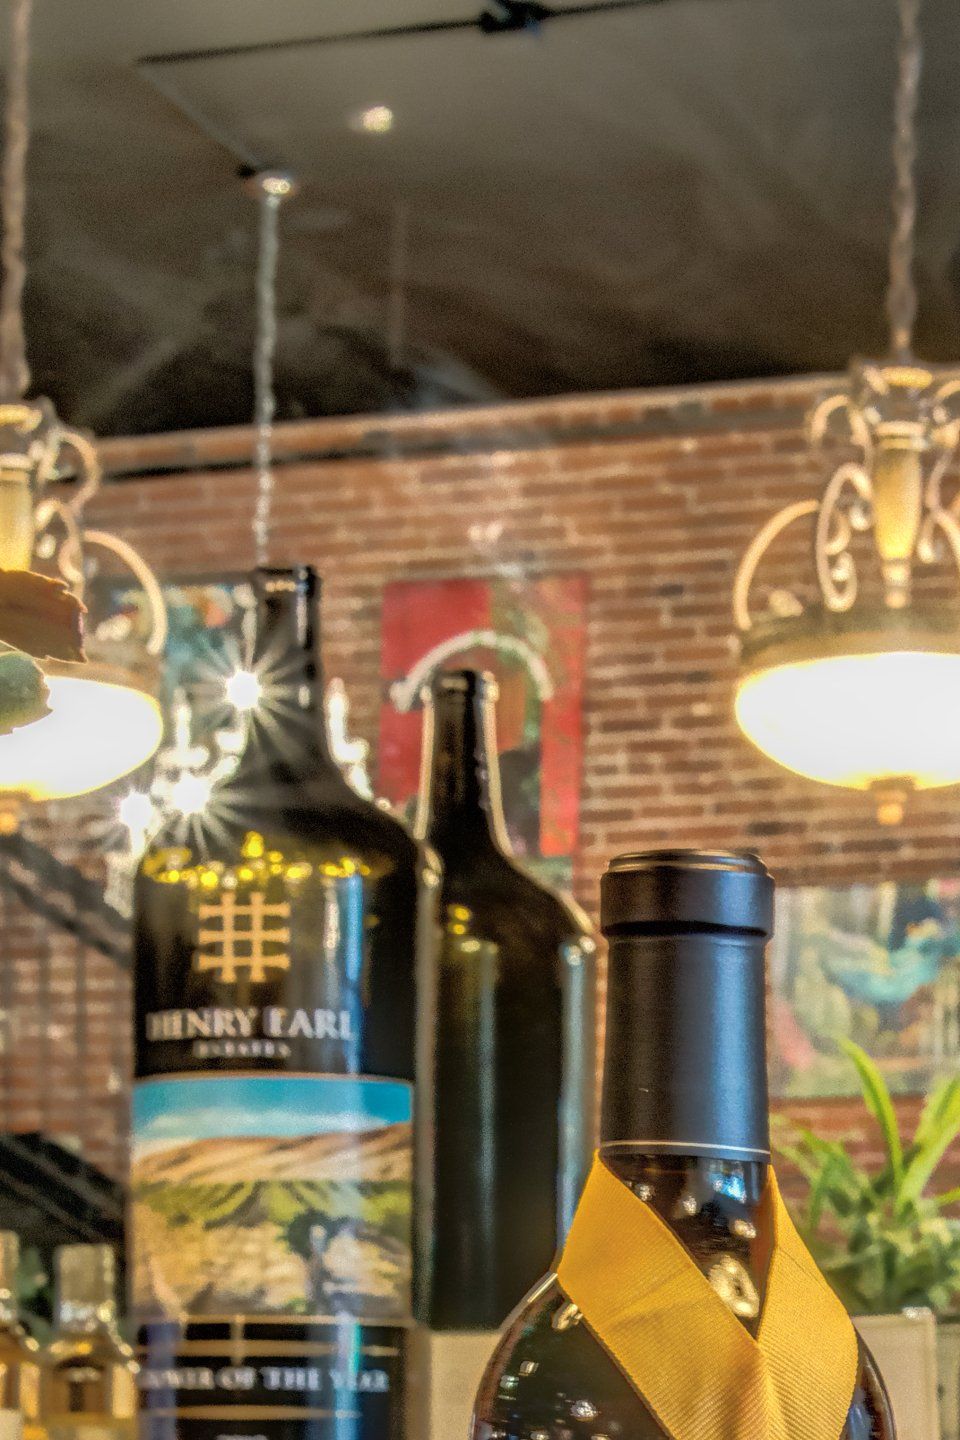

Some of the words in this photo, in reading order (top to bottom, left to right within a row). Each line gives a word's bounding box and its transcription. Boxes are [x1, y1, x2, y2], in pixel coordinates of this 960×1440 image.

[263, 1005, 355, 1039] EARL
[215, 1367, 257, 1390] OF
[260, 1366, 320, 1391] THE
